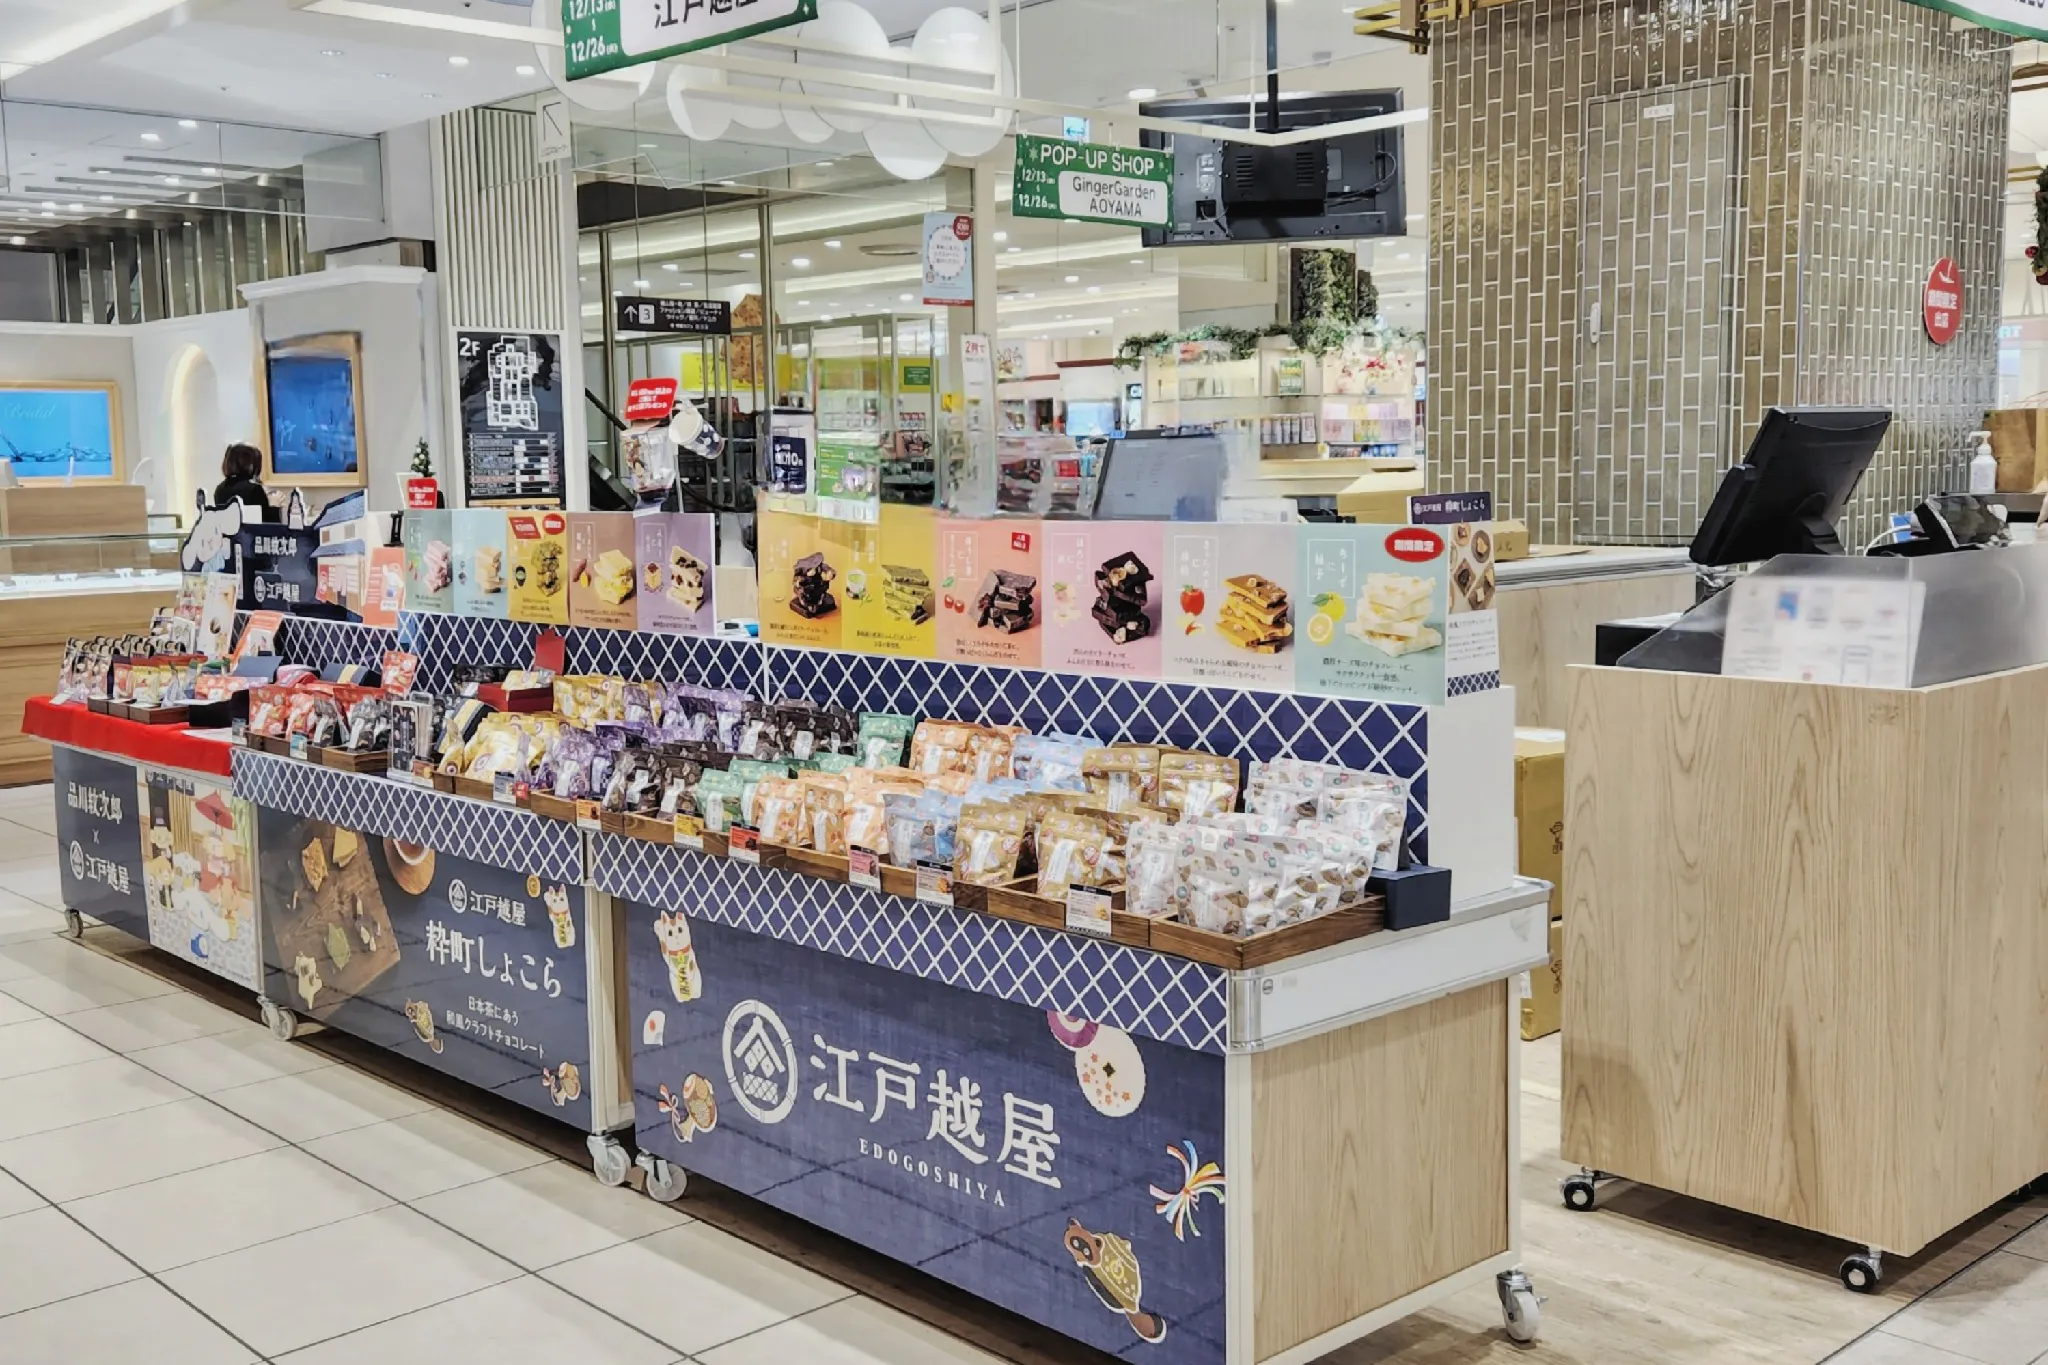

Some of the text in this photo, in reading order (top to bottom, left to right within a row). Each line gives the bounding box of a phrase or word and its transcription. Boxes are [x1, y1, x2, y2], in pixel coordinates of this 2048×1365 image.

[1040, 143, 1155, 176] POP-UP SHOP
[1089, 198, 1142, 216] AOYAMA
[643, 308, 651, 320] 3
[459, 337, 481, 356] 2F
[85, 853, 131, 895] 江戸越屋
[470, 890, 526, 927] 江戸越屋
[425, 919, 562, 998] 粋町しょこら
[467, 996, 519, 1027] 日本茶にあう
[446, 1010, 545, 1060] 和風クラフトチョコレート
[810, 1033, 1062, 1190] 江戸越屋
[859, 1138, 1006, 1207] EDOGOSHIYA
